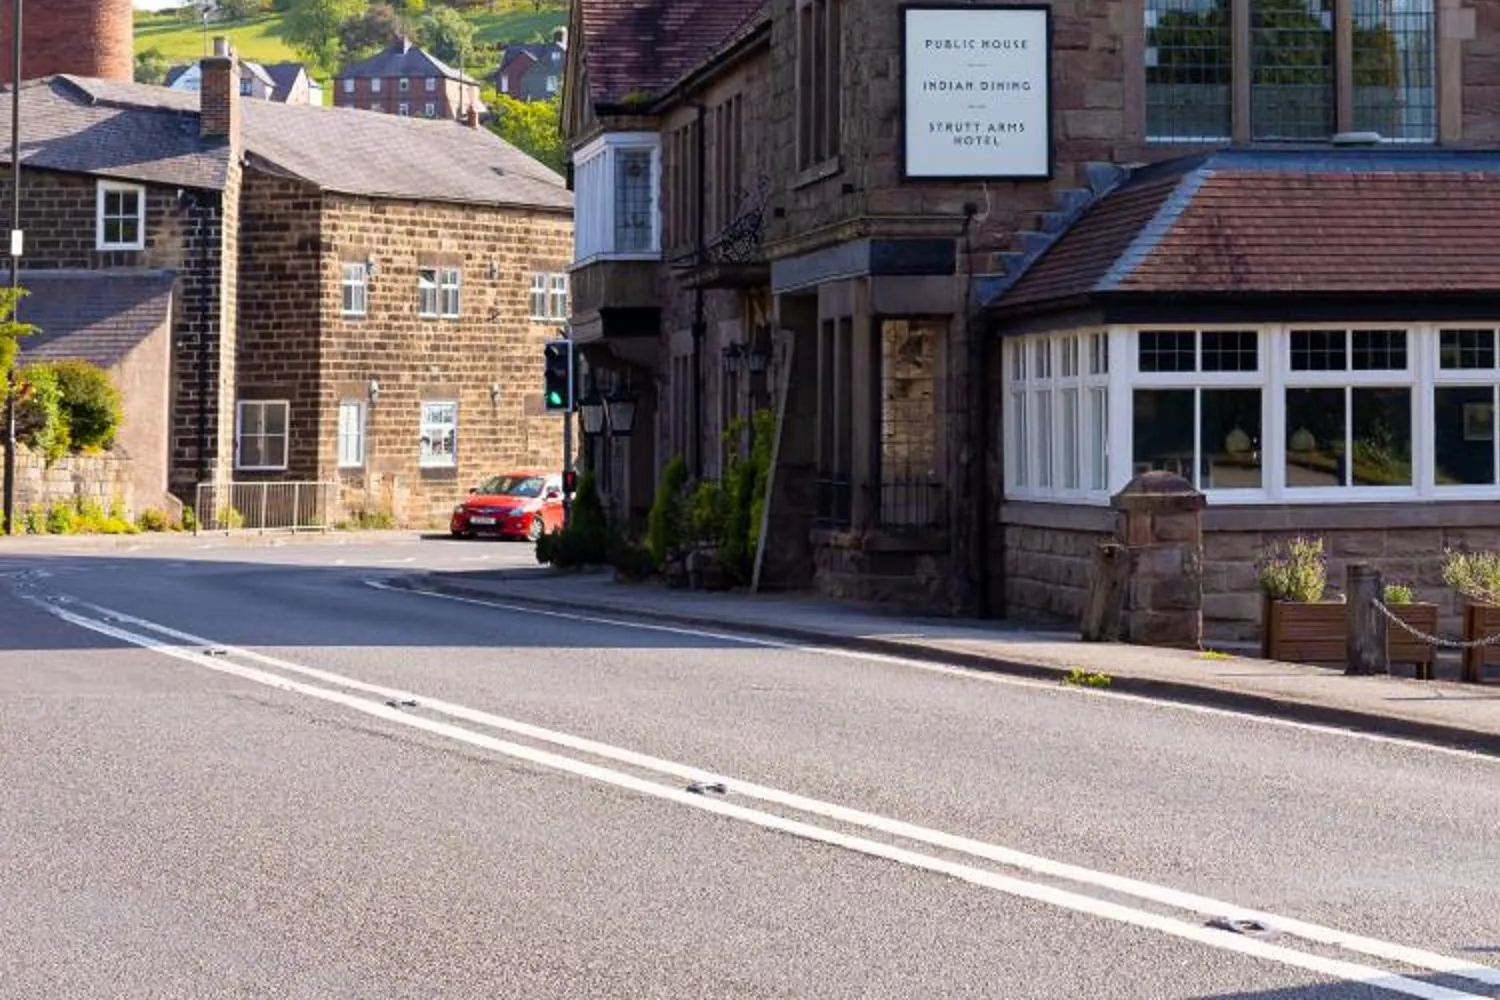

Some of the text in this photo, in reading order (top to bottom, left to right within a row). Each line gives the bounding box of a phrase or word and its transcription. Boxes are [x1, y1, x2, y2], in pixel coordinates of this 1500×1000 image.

[924, 39, 1028, 49] PUBLIC HOUSE
[923, 80, 1031, 91] INDIAN DINING
[928, 121, 1025, 133] STRUTT ARMS
[953, 135, 1000, 146] HOTEL
